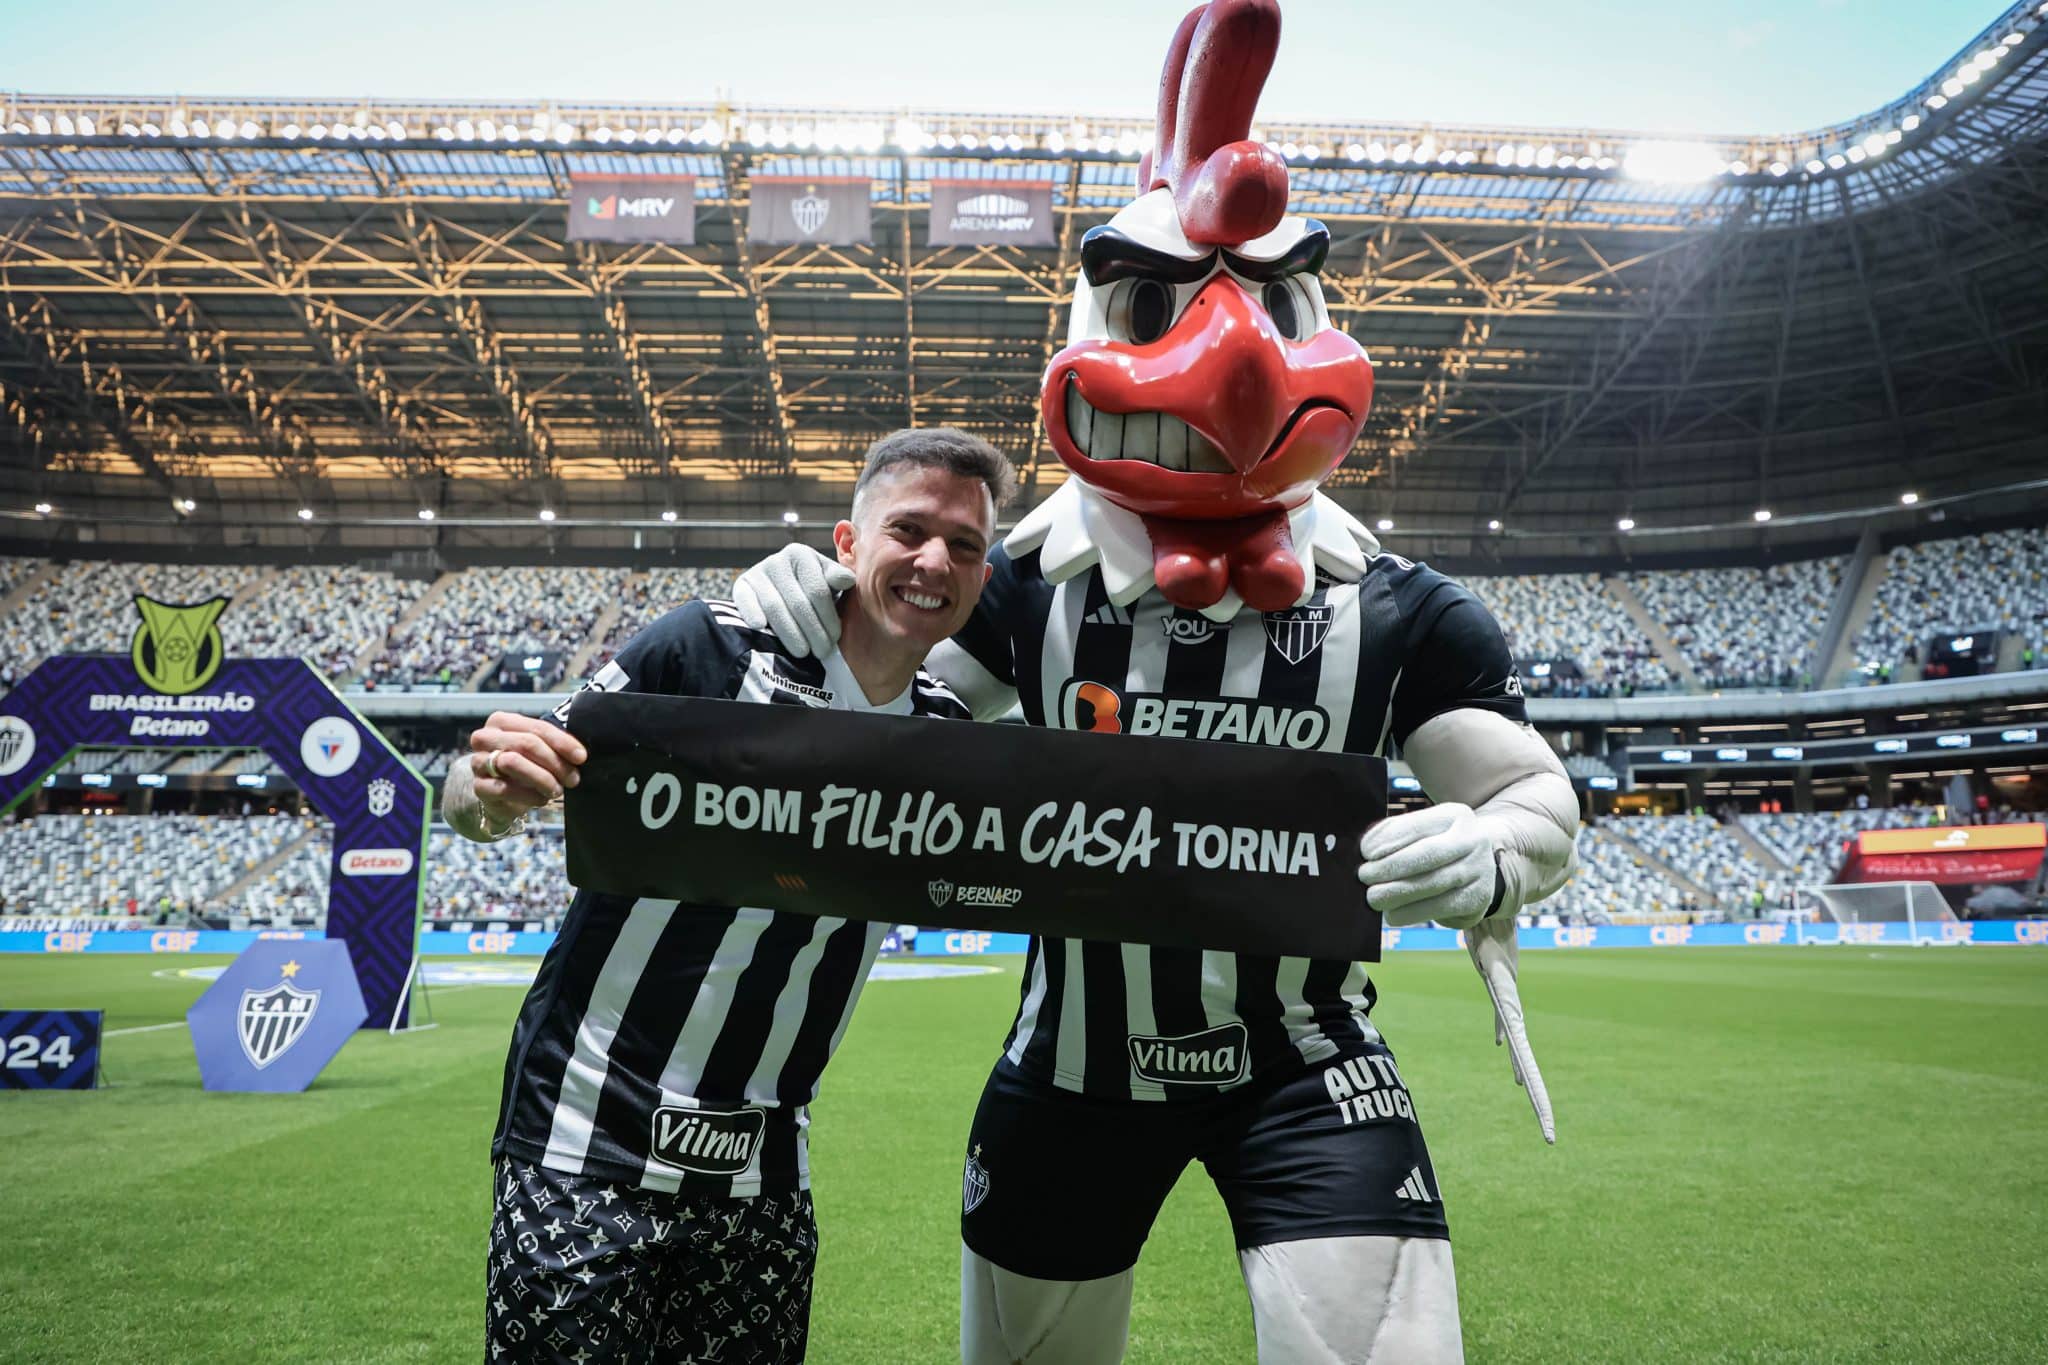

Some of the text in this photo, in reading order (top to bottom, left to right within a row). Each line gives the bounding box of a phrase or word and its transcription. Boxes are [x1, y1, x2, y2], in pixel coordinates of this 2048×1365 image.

[618, 198, 674, 217] MRV
[762, 668, 834, 702] Multimarcas
[89, 692, 255, 712] BRASILEIRÃO
[129, 715, 210, 737] Betano
[1130, 698, 1325, 750] BETANO
[694, 782, 802, 835] BOM
[810, 784, 964, 856] FILHO
[972, 807, 1005, 851] A
[1019, 801, 1160, 874] CASA
[957, 886, 1022, 905] BERNARD
[45, 932, 93, 953] CBF
[151, 931, 200, 953] CBF
[468, 932, 517, 953] CBF
[944, 933, 993, 953] CBF
[1553, 927, 1598, 946] CBF
[1650, 925, 1693, 944] CBF
[1744, 924, 1788, 944] CBF
[252, 998, 307, 1012] CAM
[0, 1034, 75, 1069] 24
[1134, 1041, 1236, 1073] Vilma
[658, 1114, 751, 1161] Vilma
